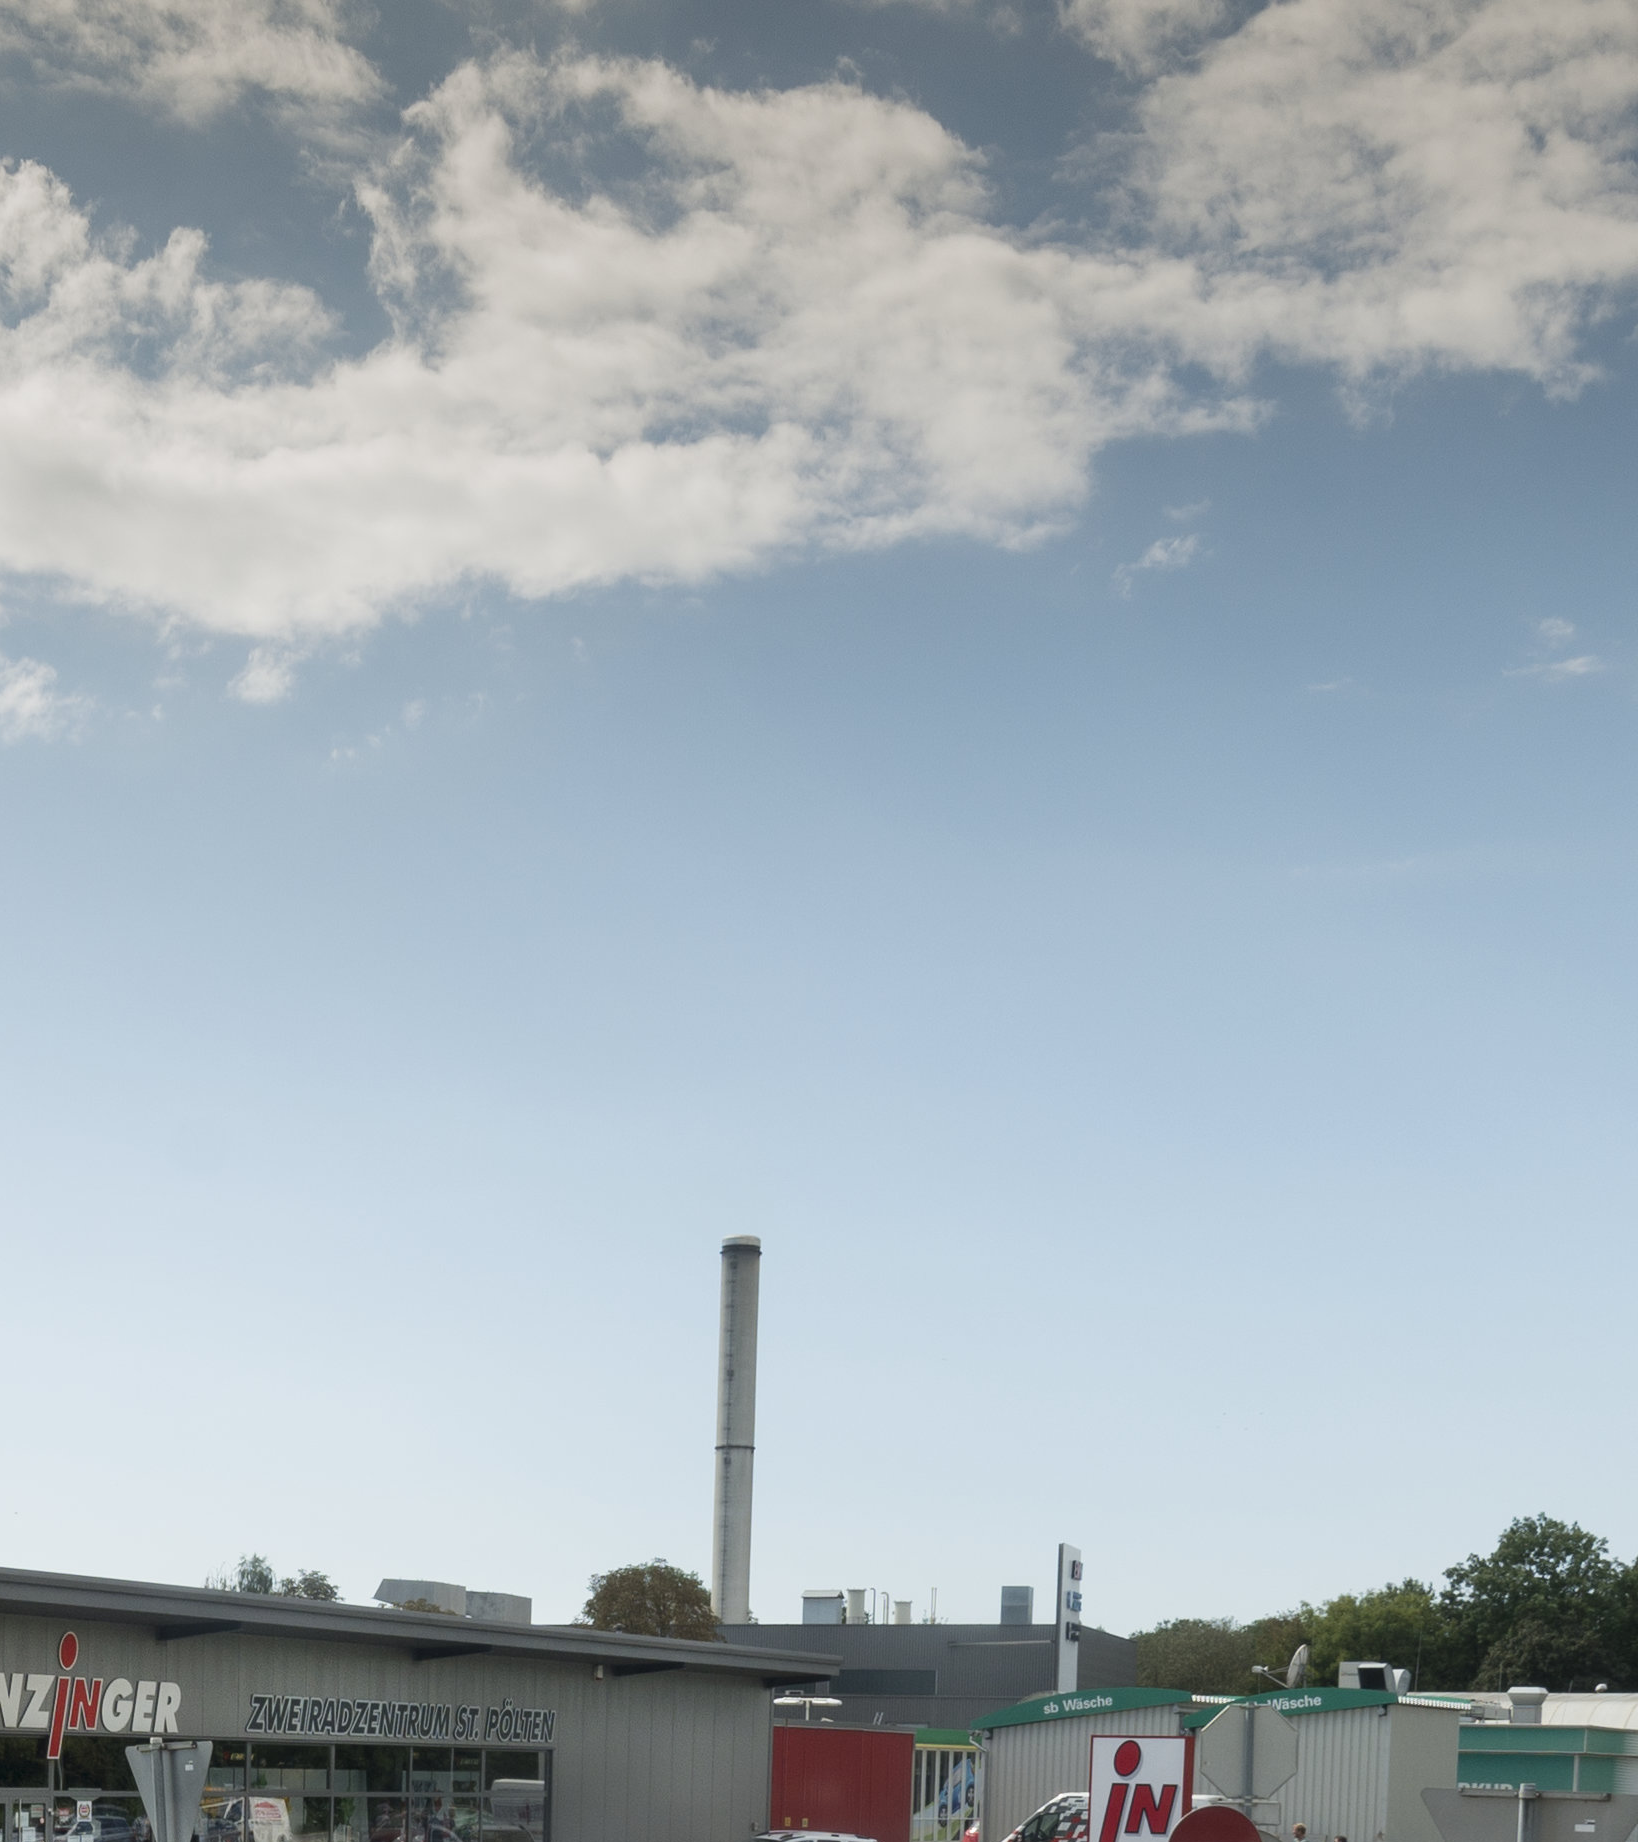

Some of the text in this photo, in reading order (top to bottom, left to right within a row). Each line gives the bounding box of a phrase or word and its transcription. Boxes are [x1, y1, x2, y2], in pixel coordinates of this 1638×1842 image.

[245, 1694, 557, 1744] ZWEIRADZENTRUM ST. PÖLTEN
[1044, 1695, 1113, 1715] sb Wäsche
